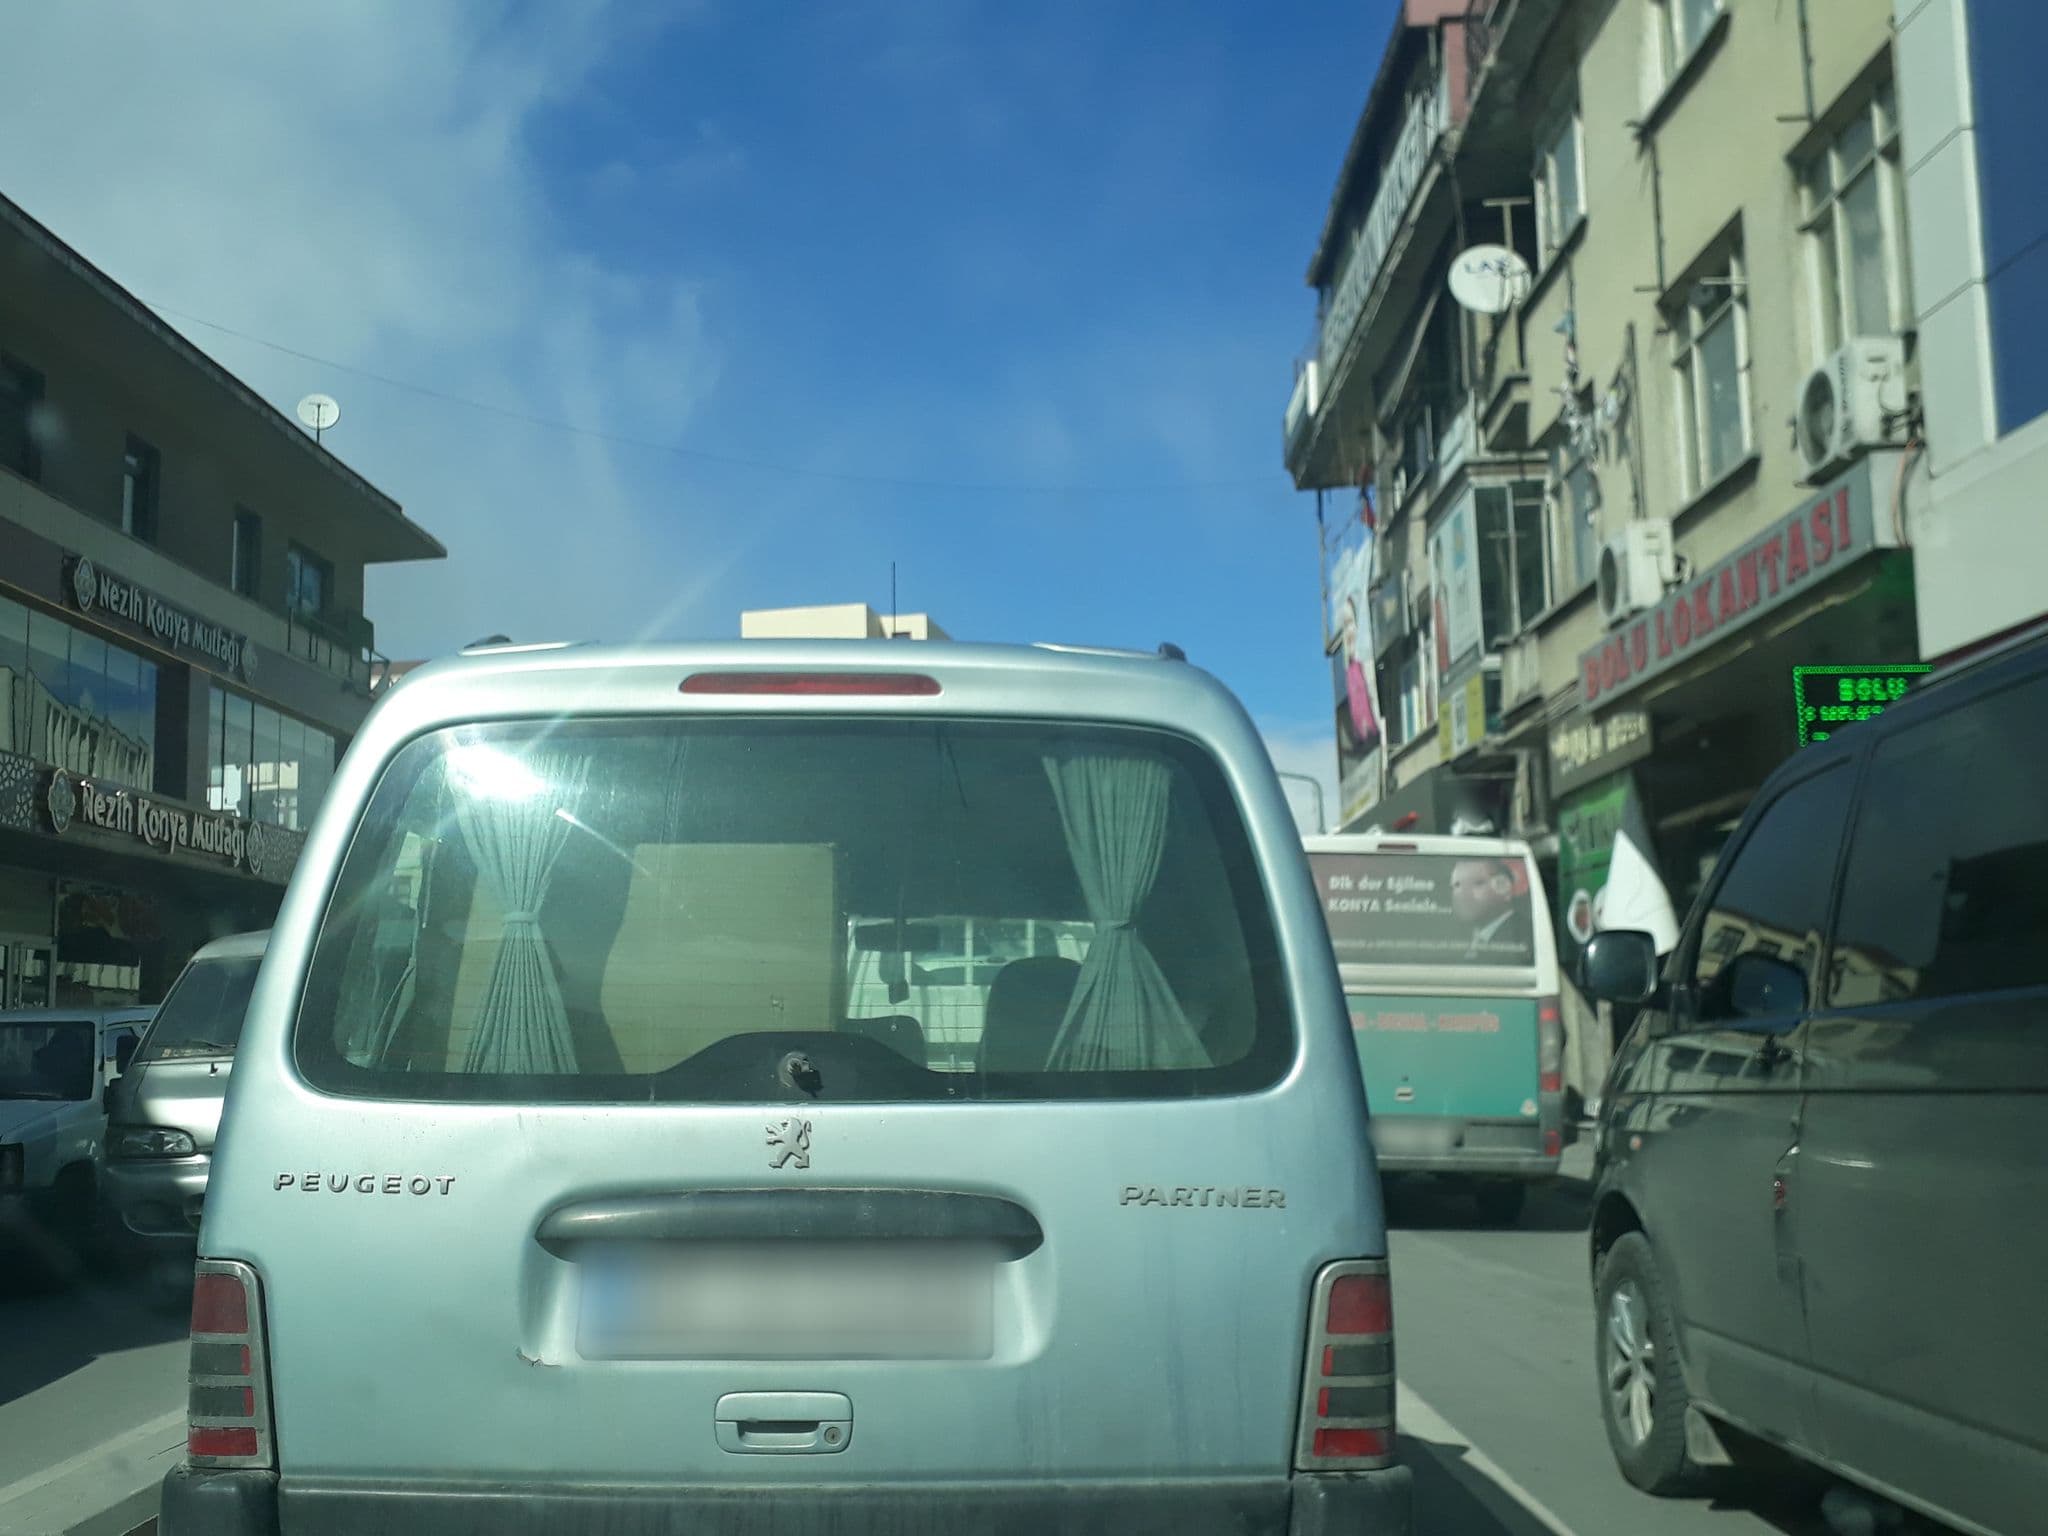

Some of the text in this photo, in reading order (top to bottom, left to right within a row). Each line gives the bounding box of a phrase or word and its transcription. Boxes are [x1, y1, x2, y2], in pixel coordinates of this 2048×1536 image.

[1584, 487, 1853, 701] BOLU LOKANTASI
[146, 597, 190, 648] Konya
[137, 797, 189, 854] Konya
[1328, 898, 1380, 913] KONYA
[273, 1172, 456, 1196] PEUGEOT
[1119, 1184, 1287, 1209] PARTNER
